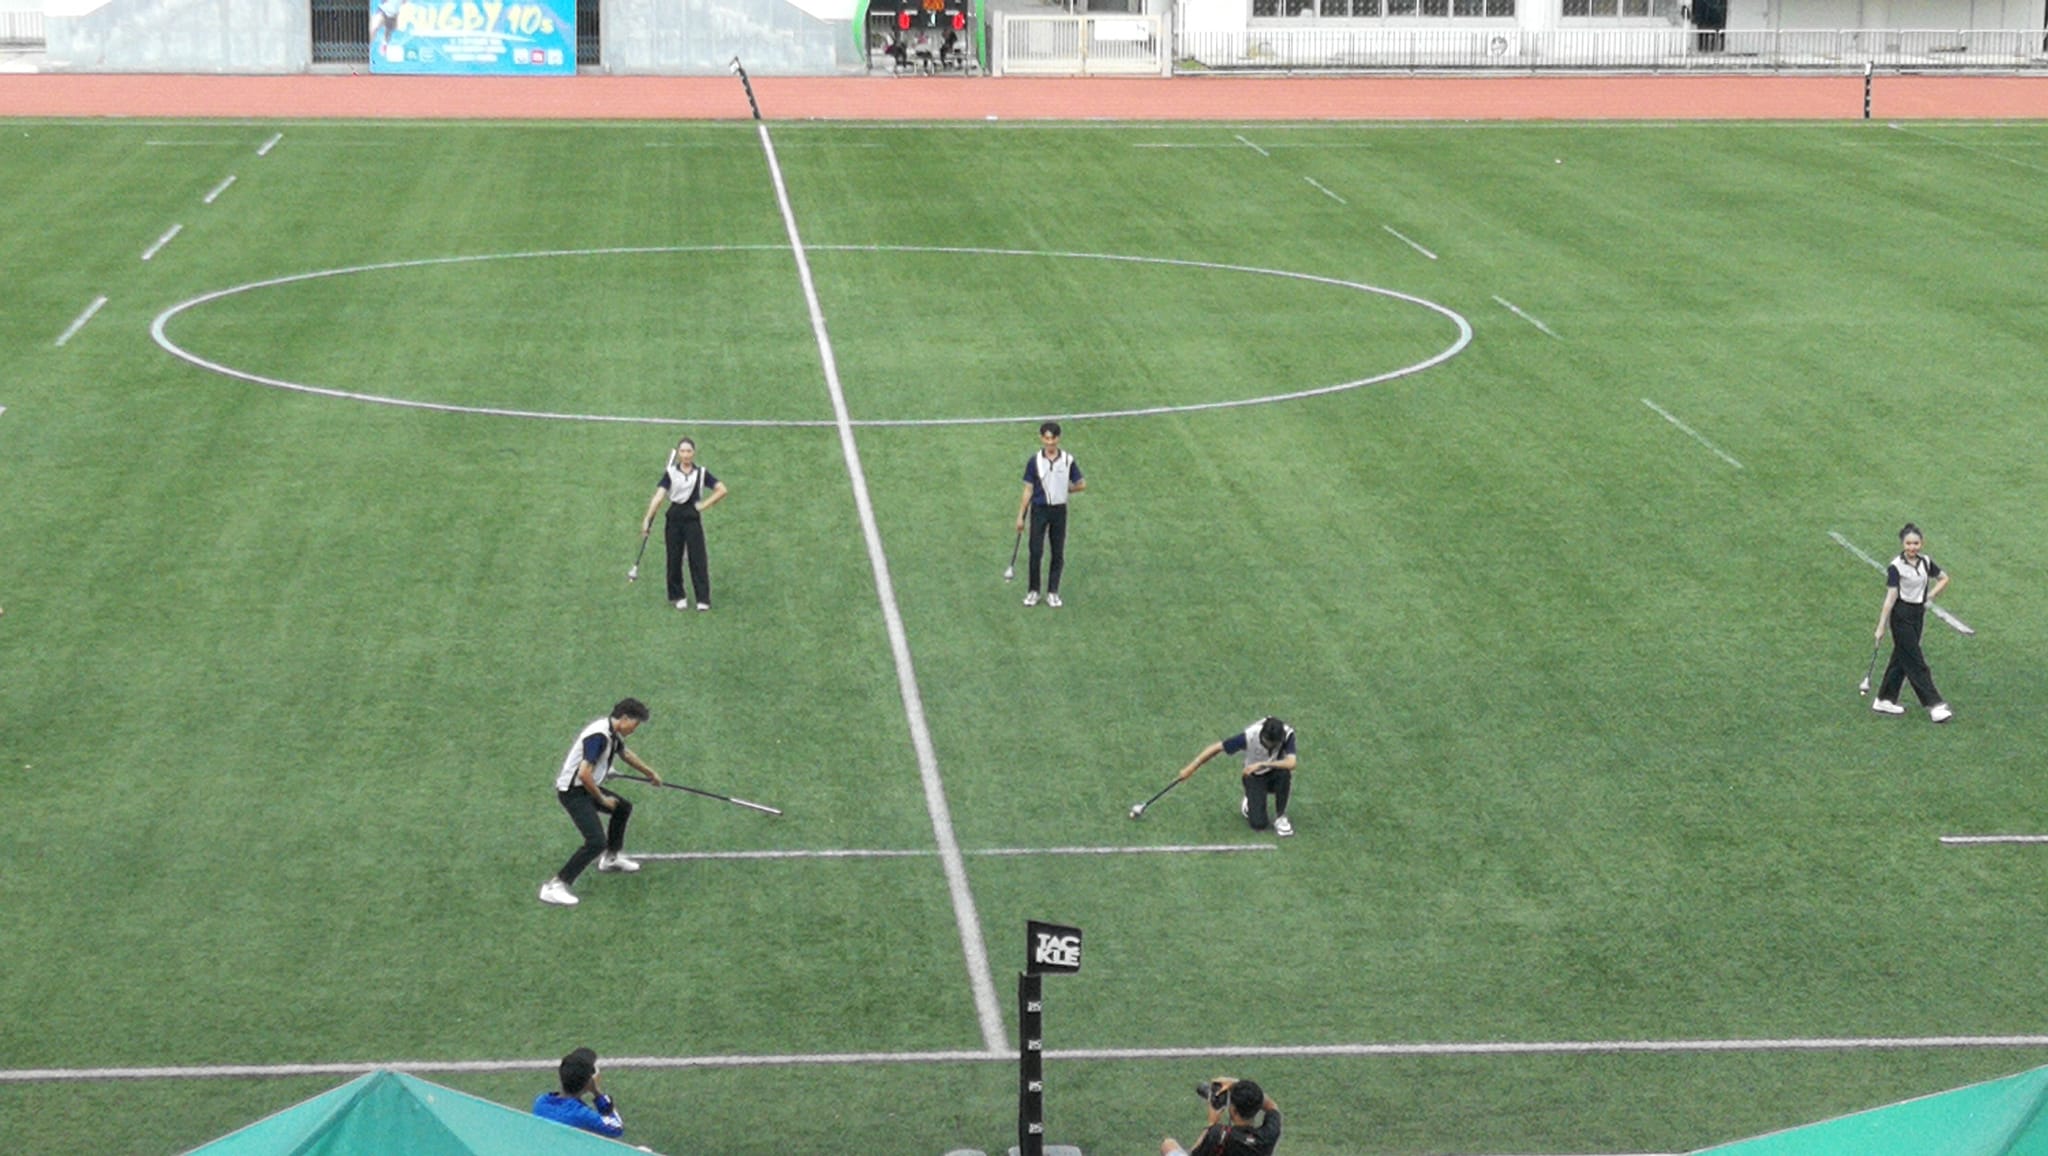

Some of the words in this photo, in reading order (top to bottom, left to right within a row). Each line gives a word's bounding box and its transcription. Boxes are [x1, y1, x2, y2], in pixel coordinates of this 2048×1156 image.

[397, 1, 502, 31] RUGBY
[1036, 933, 1080, 950] TAC
[1036, 948, 1080, 966] KLE
